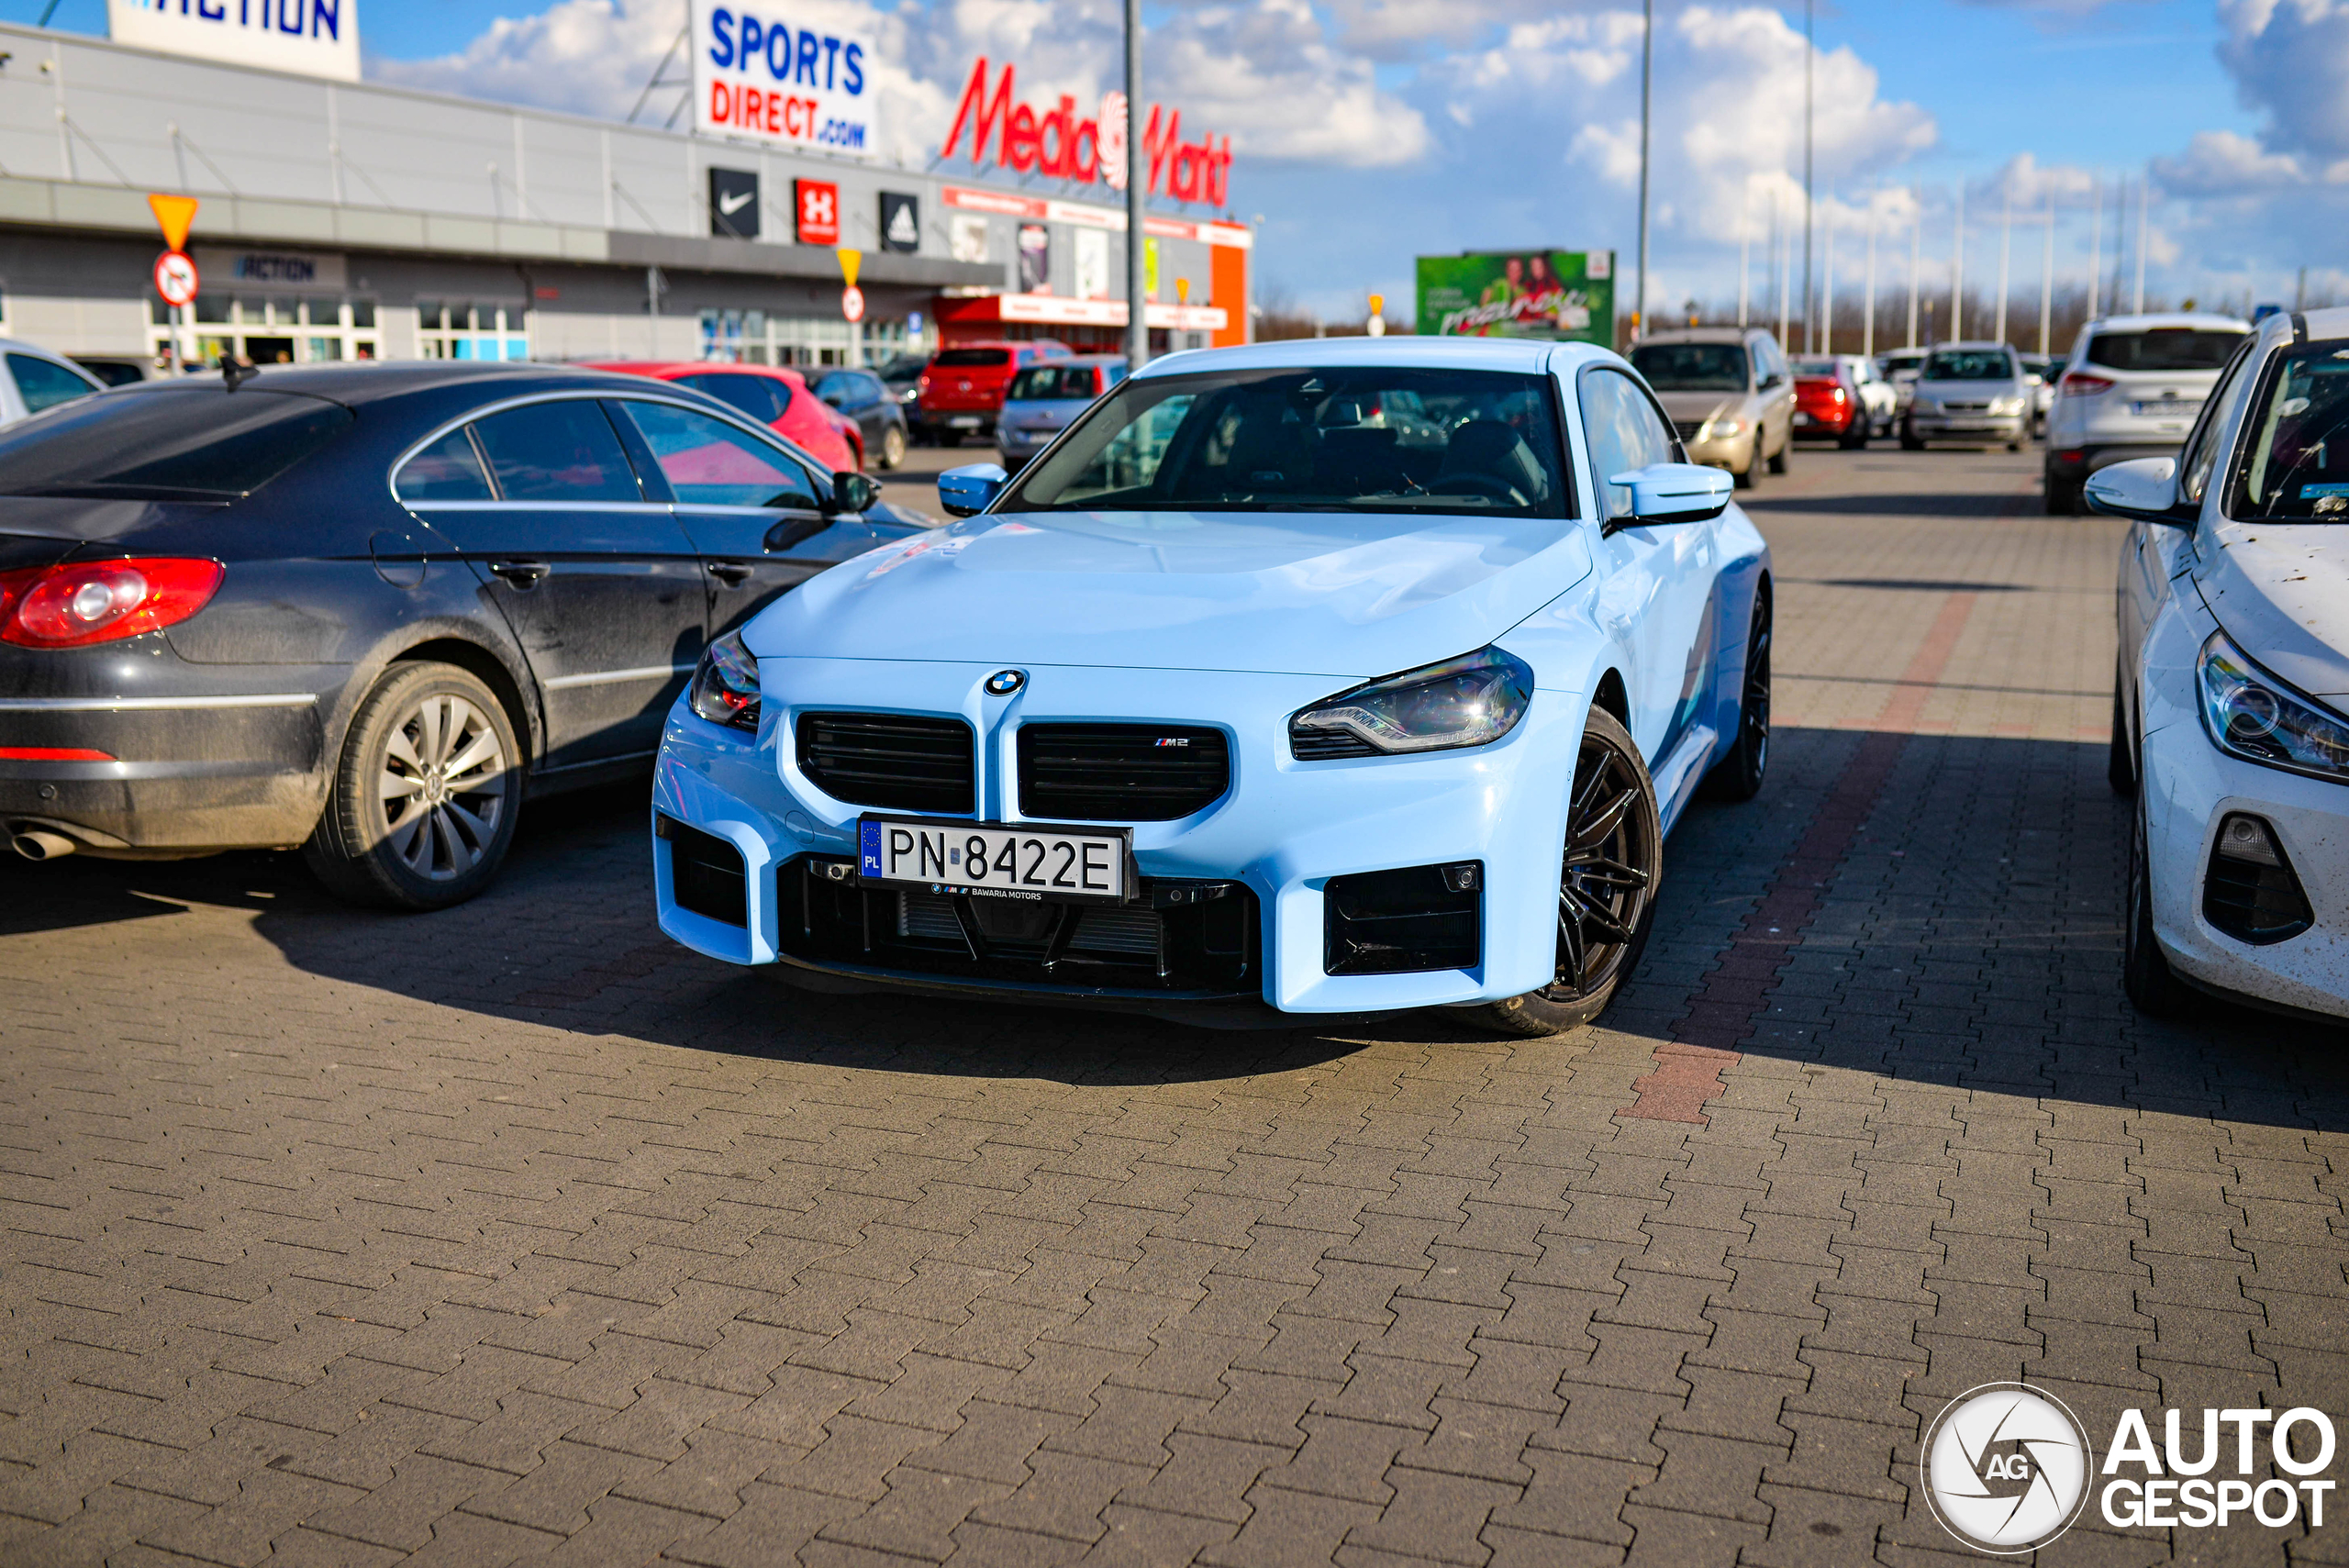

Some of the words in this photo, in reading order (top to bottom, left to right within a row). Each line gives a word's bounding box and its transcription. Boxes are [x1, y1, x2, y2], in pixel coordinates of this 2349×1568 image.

[710, 8, 863, 95] SPORTS
[941, 56, 1099, 184] Media
[1163, 738, 1188, 747] M2
[864, 856, 880, 869] PL
[890, 828, 945, 878] PN
[965, 835, 1109, 890] 8422E
[972, 888, 1008, 898] BAWARIA
[1008, 891, 1041, 901] MOTORS
